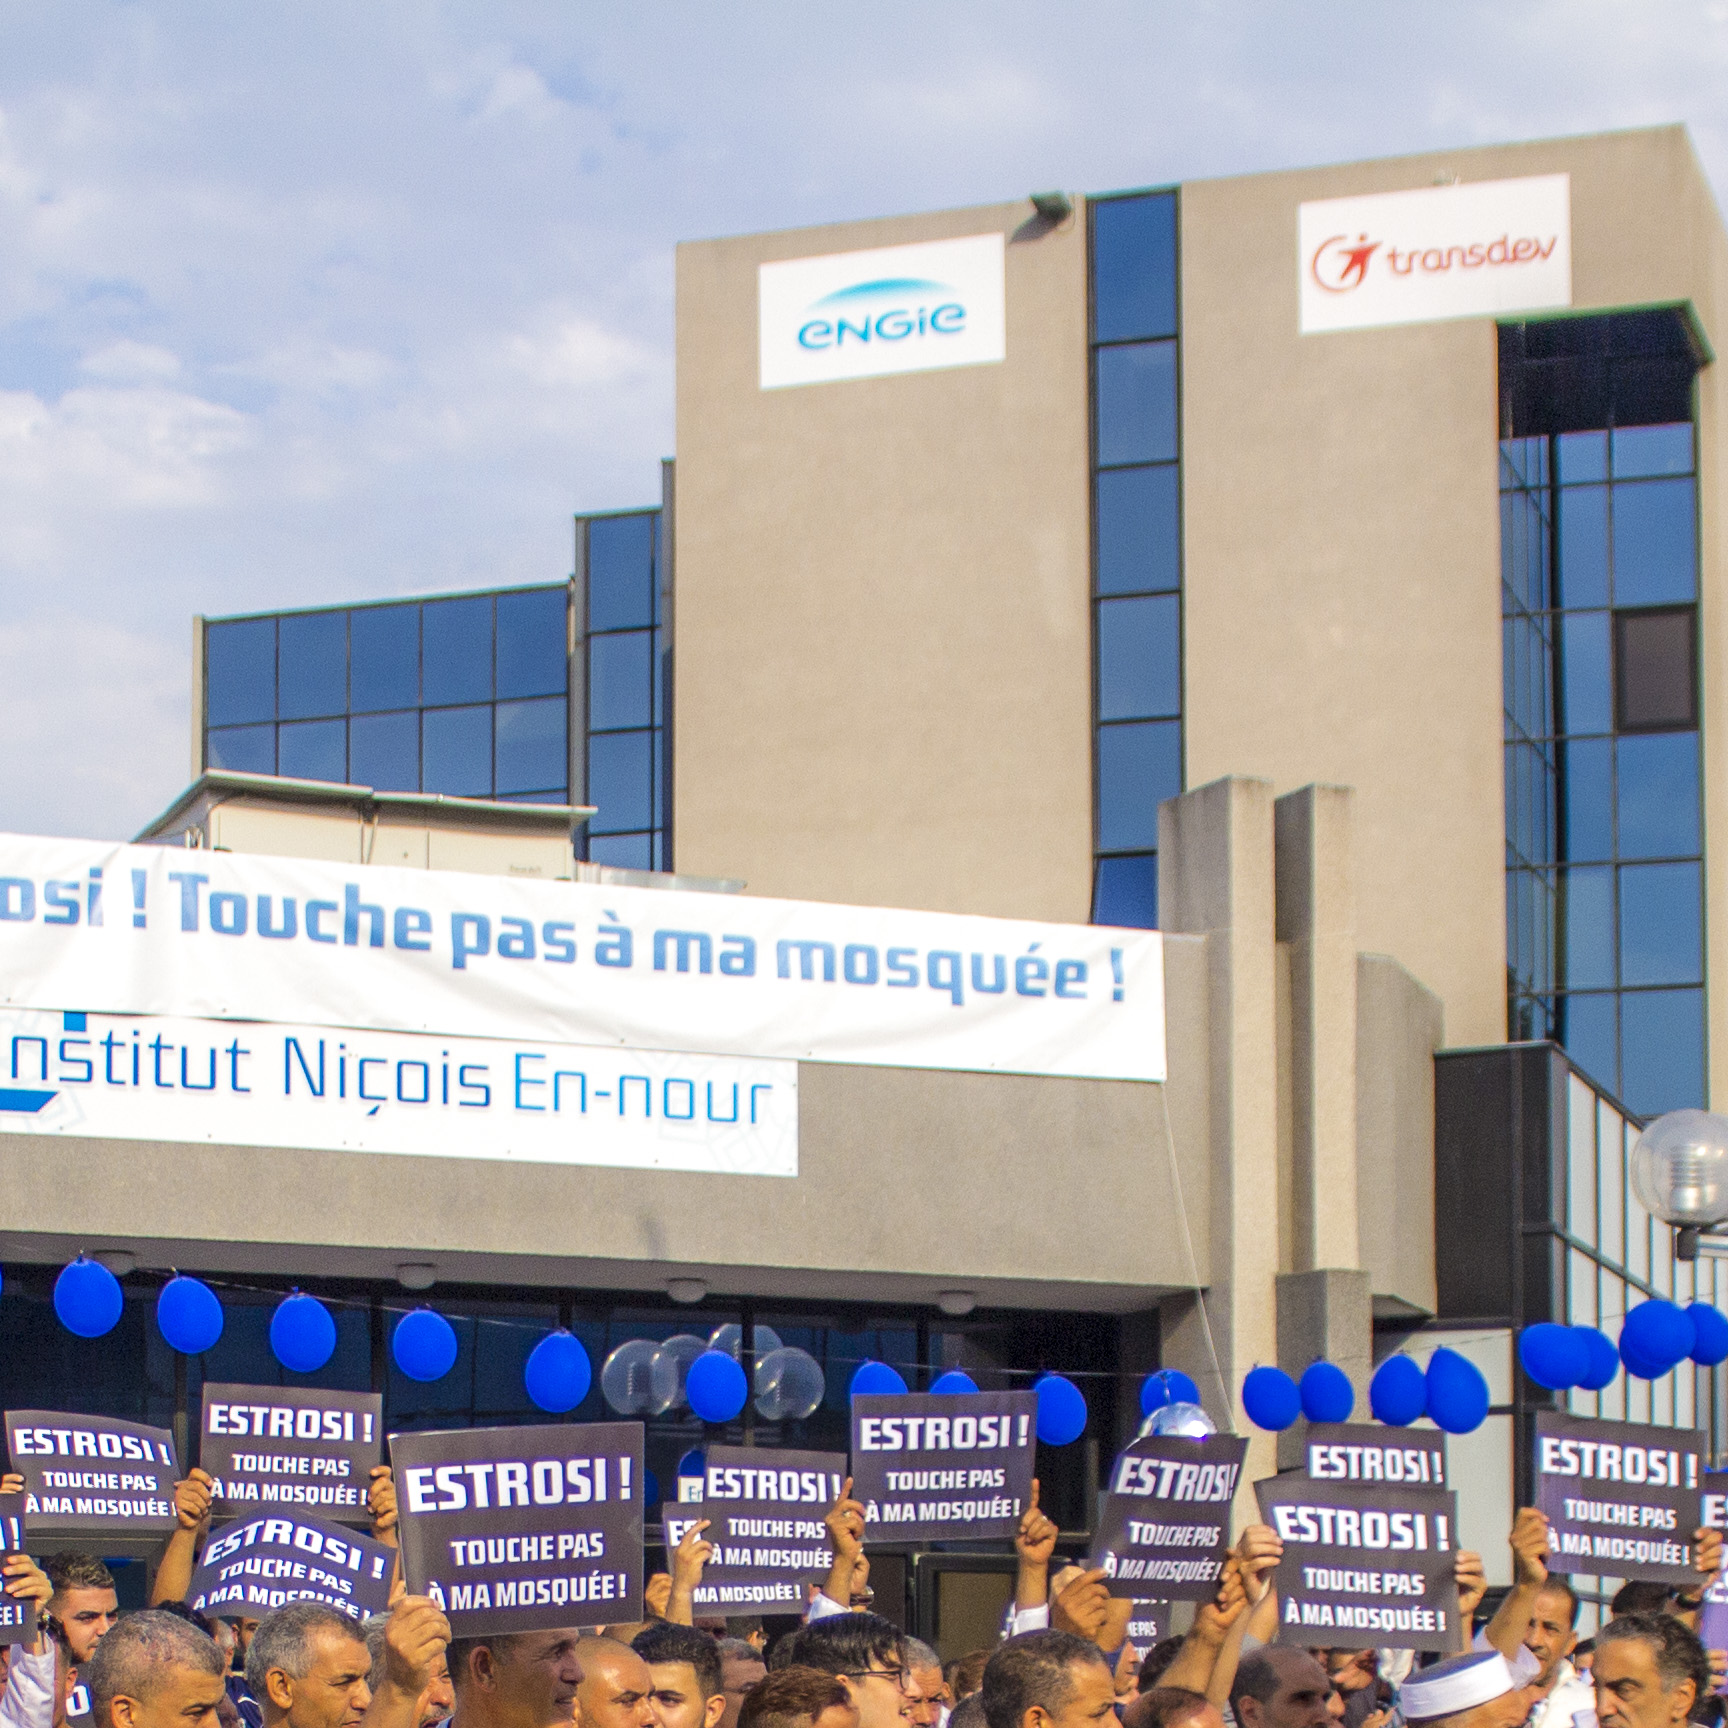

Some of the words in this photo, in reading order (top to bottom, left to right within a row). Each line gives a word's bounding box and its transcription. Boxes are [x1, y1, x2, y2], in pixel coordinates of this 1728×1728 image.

[1387, 234, 1558, 275] transdev
[169, 871, 433, 951] Touche
[451, 912, 577, 970] pas
[594, 910, 633, 967] à
[652, 928, 757, 976] ma
[776, 943, 1088, 1006] mosquée
[284, 1037, 492, 1116] Niçois
[515, 1052, 773, 1123] En-nour
[209, 1403, 354, 1442] ESTROSI
[860, 1415, 1011, 1451] ESTROSI
[13, 1428, 155, 1462] ESTROSI
[1541, 1437, 1679, 1487] ESTROSI
[231, 1453, 310, 1475] TOUCHE
[311, 1457, 350, 1477] PAS
[886, 1470, 967, 1491] TOUCHE
[968, 1468, 1005, 1489] PAS
[1114, 1456, 1231, 1501] ESTROSI
[1310, 1445, 1430, 1482] ESTROSI
[41, 1471, 119, 1490] TOUCHE
[120, 1474, 157, 1491] PAS
[211, 1477, 224, 1499] À
[227, 1481, 259, 1501] MA
[261, 1483, 357, 1506] MOSQUÉE
[404, 1458, 607, 1513] ESTROSI
[707, 1467, 827, 1503] ESTROSI
[25, 1493, 41, 1514] À
[42, 1496, 74, 1514] MA
[75, 1497, 169, 1518] MOSQUÉE
[865, 1500, 880, 1522] À
[883, 1503, 916, 1522] MA
[918, 1495, 1012, 1522] MOSQUÉE
[1564, 1498, 1640, 1526] TOUCHE
[1640, 1506, 1677, 1530] PAS
[727, 1518, 794, 1538] TOUCHE
[794, 1520, 826, 1539] PAS
[1128, 1521, 1197, 1546] TOUCHE
[1192, 1525, 1221, 1547] PAS
[1271, 1505, 1428, 1550] ESTROSI
[203, 1519, 362, 1571] ESTROSI
[450, 1535, 554, 1567] TOUCHE
[557, 1532, 604, 1560] PAS
[709, 1543, 722, 1565] À
[724, 1547, 752, 1566] MA
[753, 1547, 833, 1570] MOSQUÉE
[1561, 1533, 1592, 1555] MA
[1593, 1536, 1682, 1565] MOSQUÉE
[220, 1557, 306, 1581] TOUCHE
[309, 1567, 353, 1594] PAS
[1104, 1551, 1117, 1579] À
[1118, 1559, 1144, 1579] MA
[1145, 1556, 1214, 1583] MOSQUÉE
[1303, 1567, 1382, 1594] TOUCHE
[1382, 1573, 1425, 1596] PAS
[209, 1584, 244, 1605] MA
[450, 1584, 491, 1611] MA
[495, 1569, 615, 1608] MOSQUÉE
[692, 1586, 719, 1603] MA
[719, 1582, 794, 1603] MOSQUÉE
[1285, 1597, 1301, 1624] À
[1302, 1603, 1335, 1627] MA
[1335, 1605, 1436, 1632] MOSQUÉE
